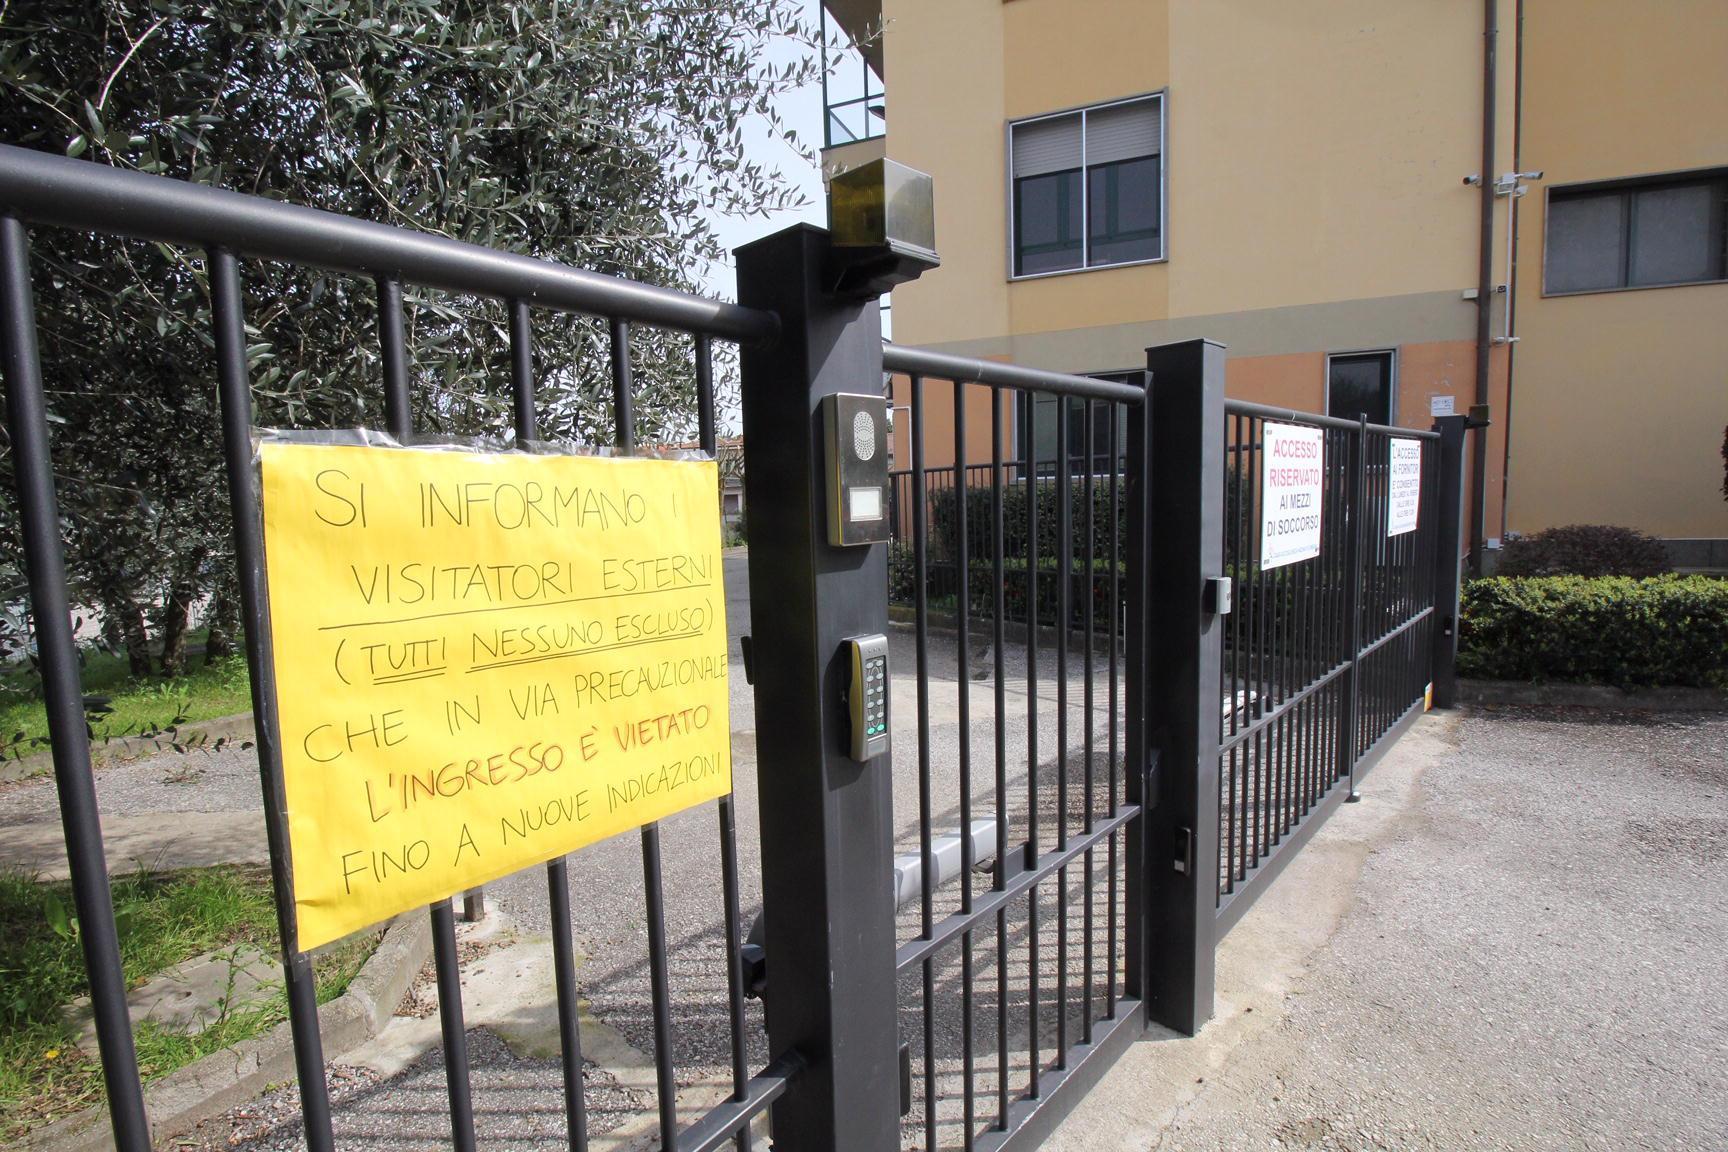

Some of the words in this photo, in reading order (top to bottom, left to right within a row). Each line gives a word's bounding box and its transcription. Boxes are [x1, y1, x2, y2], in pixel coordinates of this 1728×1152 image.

[1273, 439, 1317, 459] ACCESSO
[315, 469, 367, 529] SI
[420, 481, 646, 531] INFORMANO
[1269, 468, 1320, 488] RISERVATO
[1279, 494, 1289, 511] AI
[1290, 493, 1312, 509] MEZZI
[1267, 521, 1276, 537] DI
[1278, 515, 1319, 536] SOCCORSO
[350, 561, 573, 605] VISITATORI
[603, 554, 713, 592] ESTERNI
[333, 637, 448, 686] (TUTTI
[470, 619, 604, 662] NESSUNO
[614, 598, 715, 643] ESCLUSO)
[303, 709, 409, 763] CHE
[446, 694, 481, 736] IN
[509, 682, 559, 722] VIA
[575, 653, 729, 706] PRECAUZIONALE
[365, 742, 565, 823] L'INGRESSO
[614, 704, 711, 752] VIETATO
[342, 839, 430, 895] FINO
[454, 823, 481, 867] A
[501, 789, 592, 846] NUOVE
[606, 751, 722, 814] INDICAZIONI
